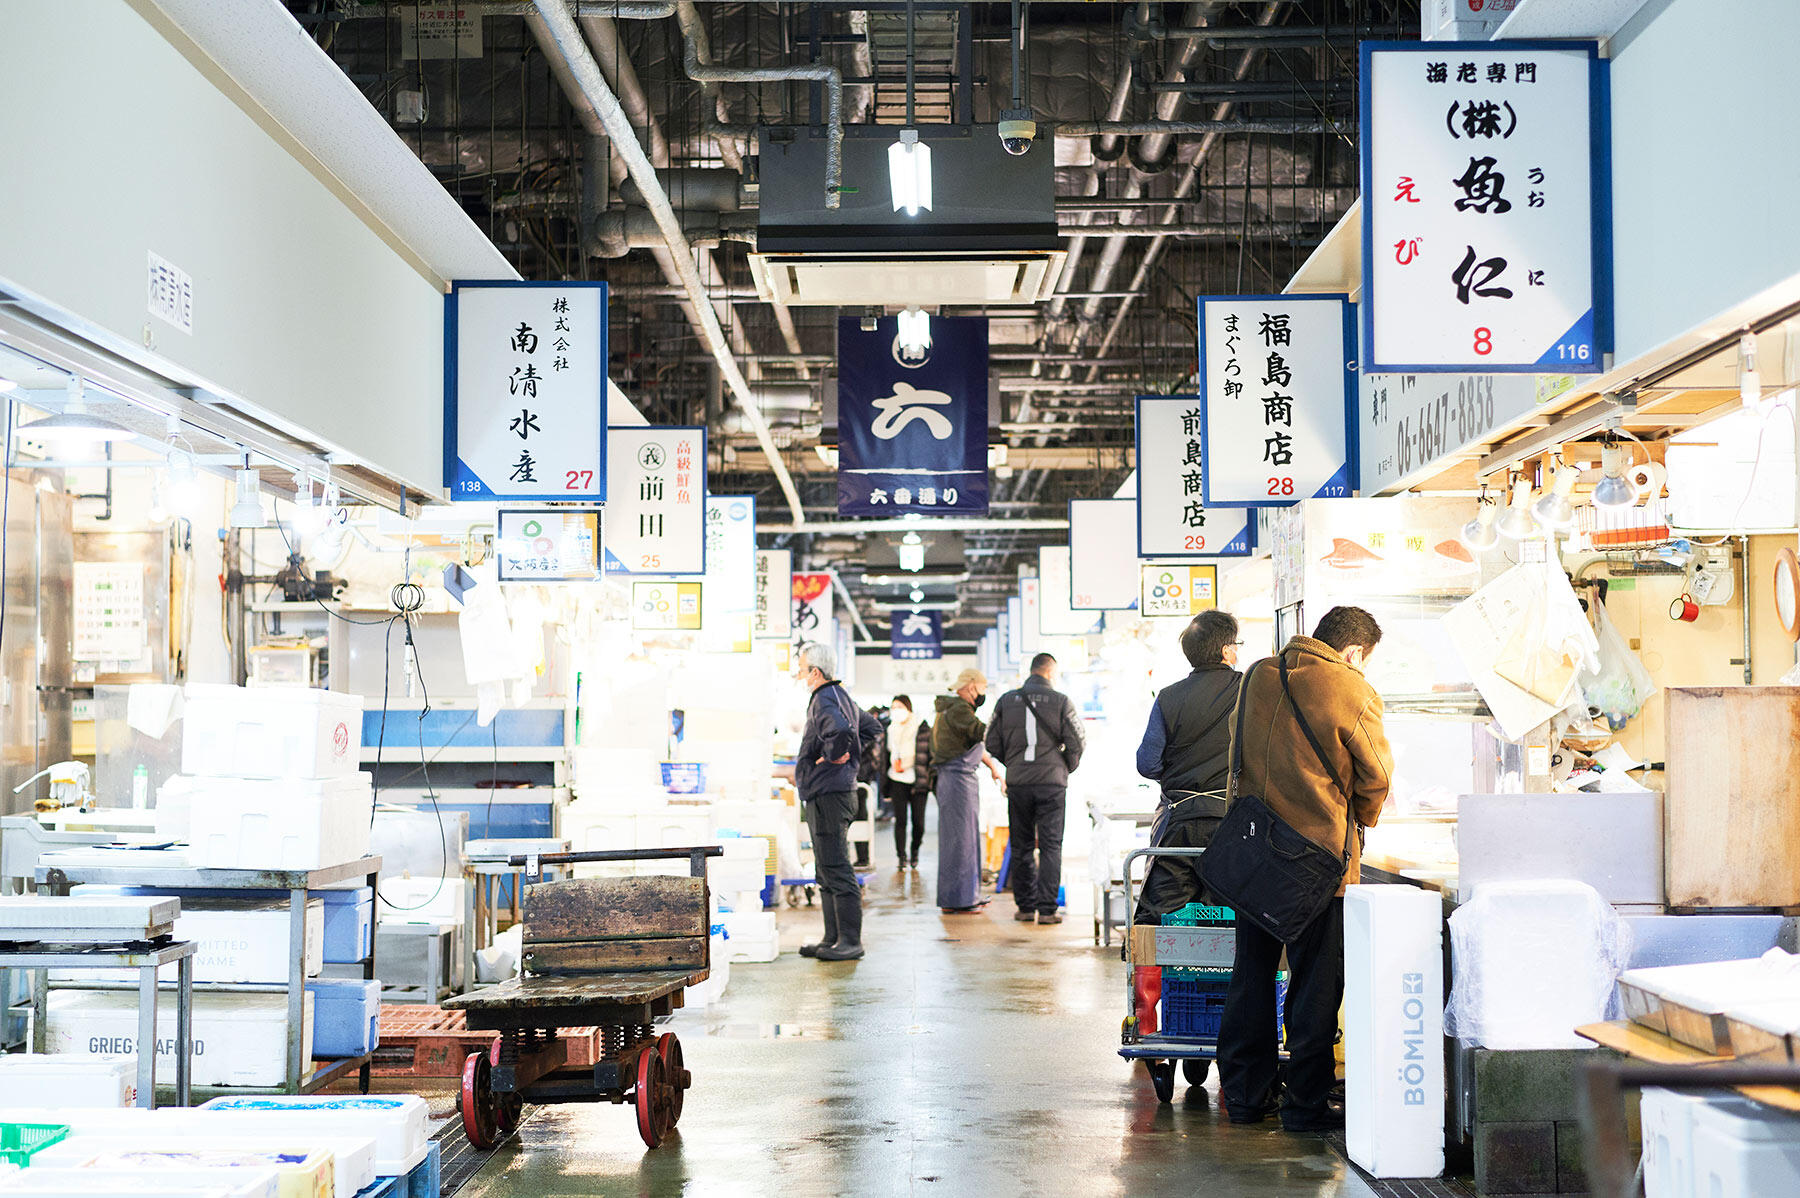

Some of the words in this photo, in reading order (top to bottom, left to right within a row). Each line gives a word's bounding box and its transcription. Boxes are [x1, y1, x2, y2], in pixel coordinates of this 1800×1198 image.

[1426, 62, 1537, 84] 海老専門
[1527, 167, 1545, 208] うお
[1394, 176, 1423, 265] えび
[1452, 156, 1513, 305] 魚仁
[1527, 268, 1545, 287] に
[552, 296, 571, 372] 株式会社
[1473, 326, 1493, 356] 8
[1223, 313, 1243, 399] まぐろ卸
[1556, 343, 1590, 360] 116
[1258, 312, 1294, 466] 福島商店
[509, 321, 543, 483] 南清水産
[871, 382, 953, 440] 六
[1397, 376, 1494, 477] 06-6647-8858
[1180, 407, 1206, 528] 前島商店
[460, 481, 481, 492] 138
[565, 470, 594, 489] 27
[1267, 477, 1294, 496] 28
[870, 487, 958, 505] 六番通り
[1324, 486, 1344, 497] 117
[1184, 535, 1206, 550] 29
[1230, 542, 1246, 551] 118
[641, 554, 661, 568] 25
[1076, 594, 1092, 606] 30
[197, 940, 249, 951] MITTED
[197, 957, 237, 966] NAME
[89, 1037, 133, 1054] GRIEG
